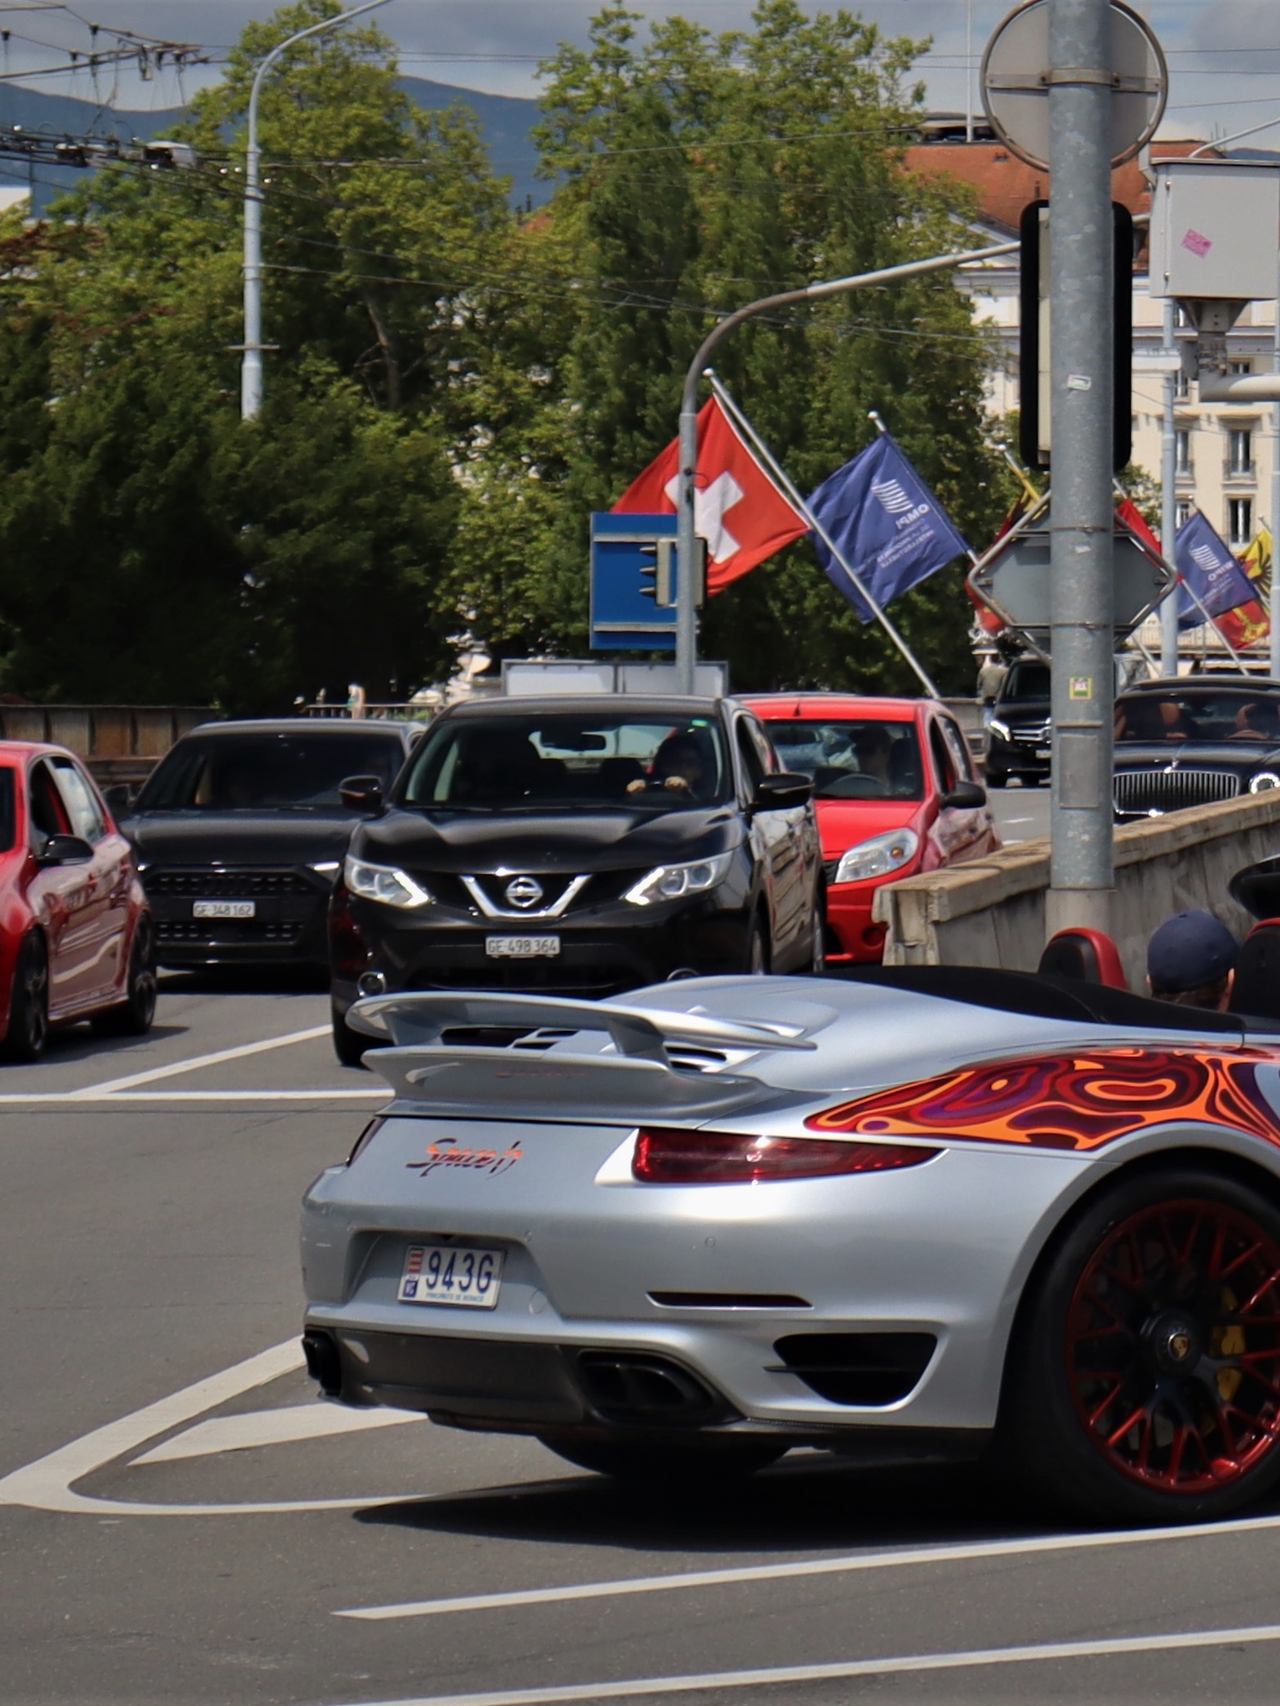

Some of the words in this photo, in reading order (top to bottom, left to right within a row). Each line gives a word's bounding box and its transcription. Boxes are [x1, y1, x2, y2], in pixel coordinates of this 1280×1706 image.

[488, 940, 504, 953] GE
[508, 940, 531, 953] 498
[534, 940, 557, 953] 364
[426, 1250, 494, 1294] 943G
